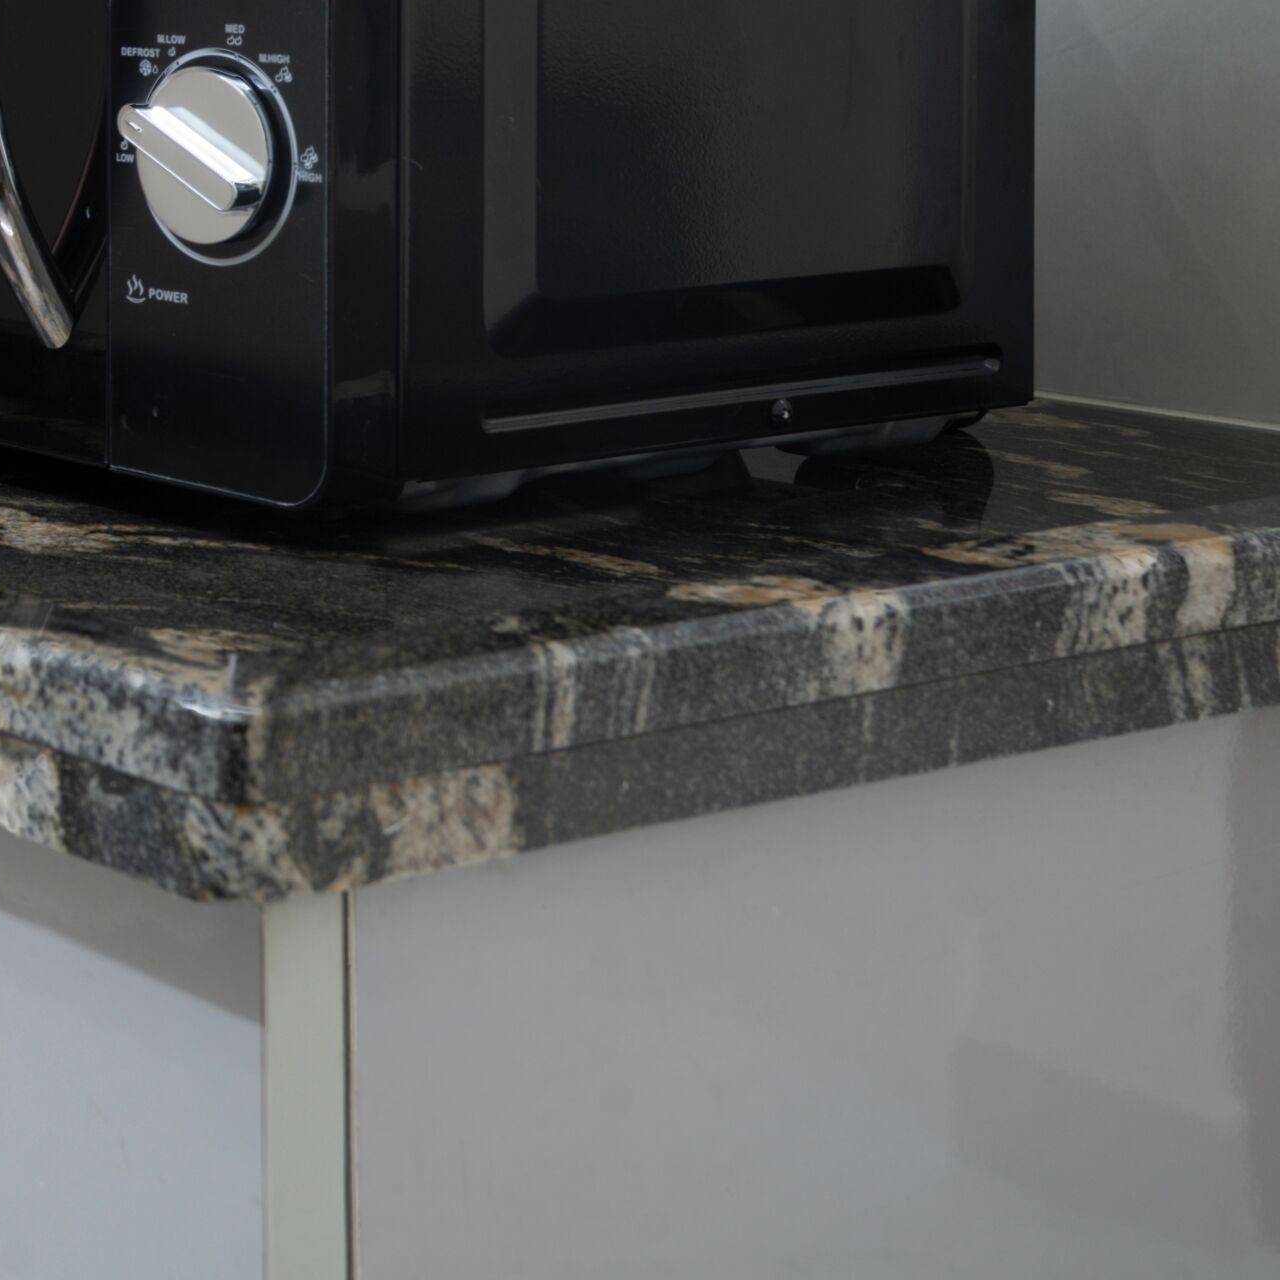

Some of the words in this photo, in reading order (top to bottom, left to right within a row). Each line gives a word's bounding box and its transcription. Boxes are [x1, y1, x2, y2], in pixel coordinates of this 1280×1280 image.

[225, 24, 245, 34] MED
[121, 47, 160, 59] DEFROST
[116, 152, 134, 163] LOW
[298, 170, 323, 184] HIGH
[148, 288, 189, 305] POWER
